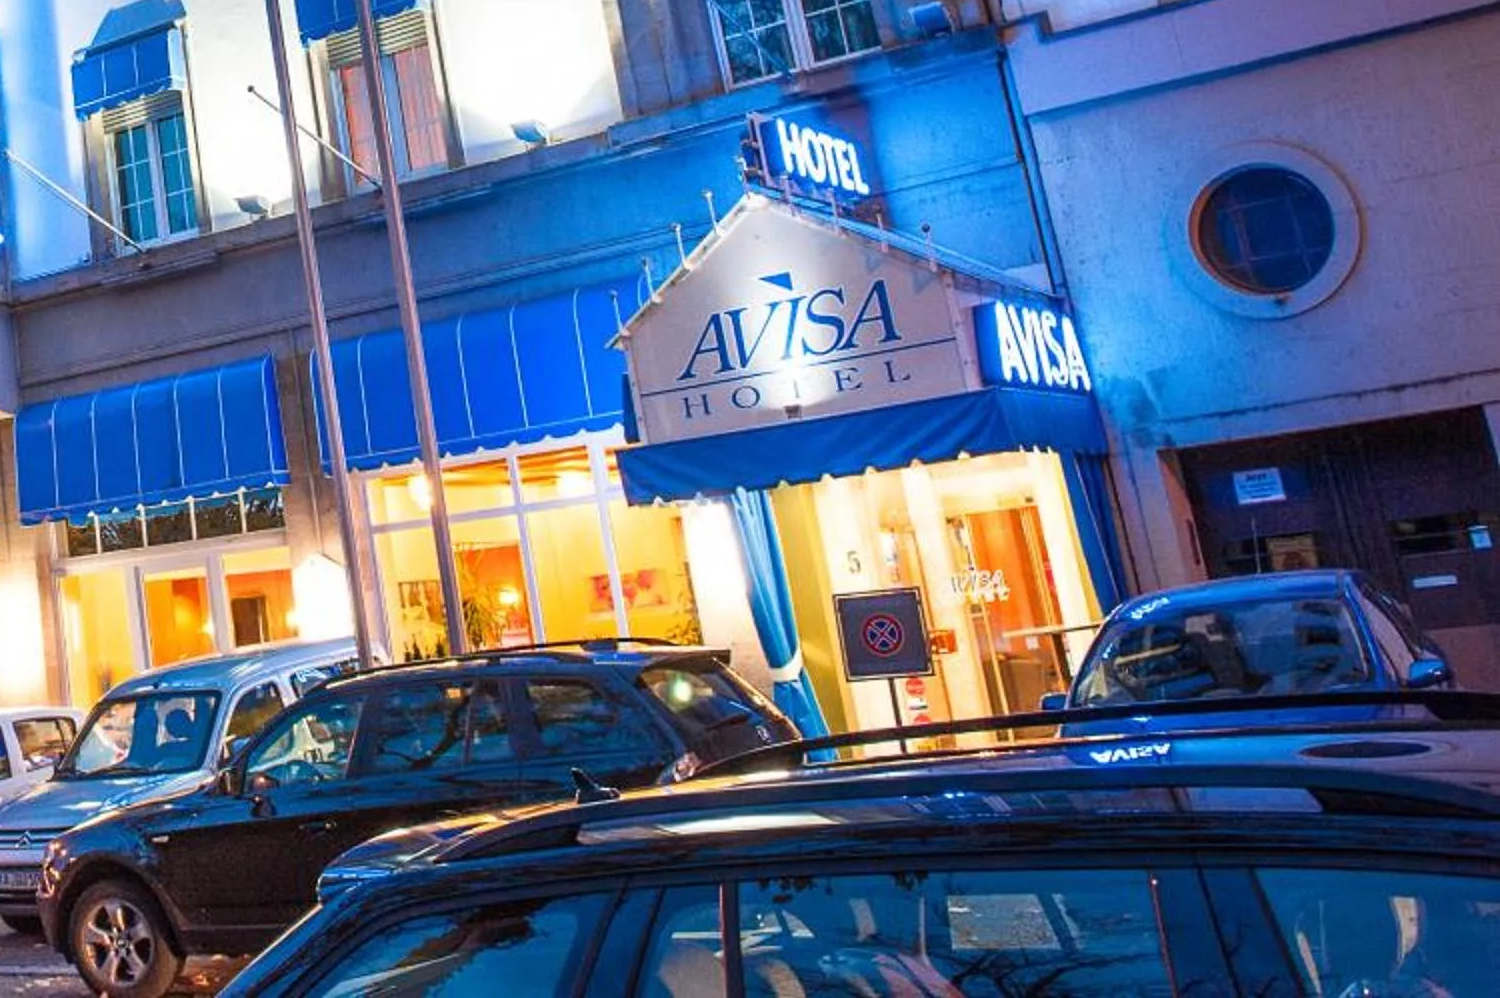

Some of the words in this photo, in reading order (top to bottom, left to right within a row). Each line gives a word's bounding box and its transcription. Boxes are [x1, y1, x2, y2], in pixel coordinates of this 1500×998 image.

[776, 118, 870, 196] HOTEL
[676, 274, 902, 381] AVISA
[994, 300, 1093, 392] AVISA
[682, 360, 911, 419] HOTEL
[846, 549, 862, 574] 5
